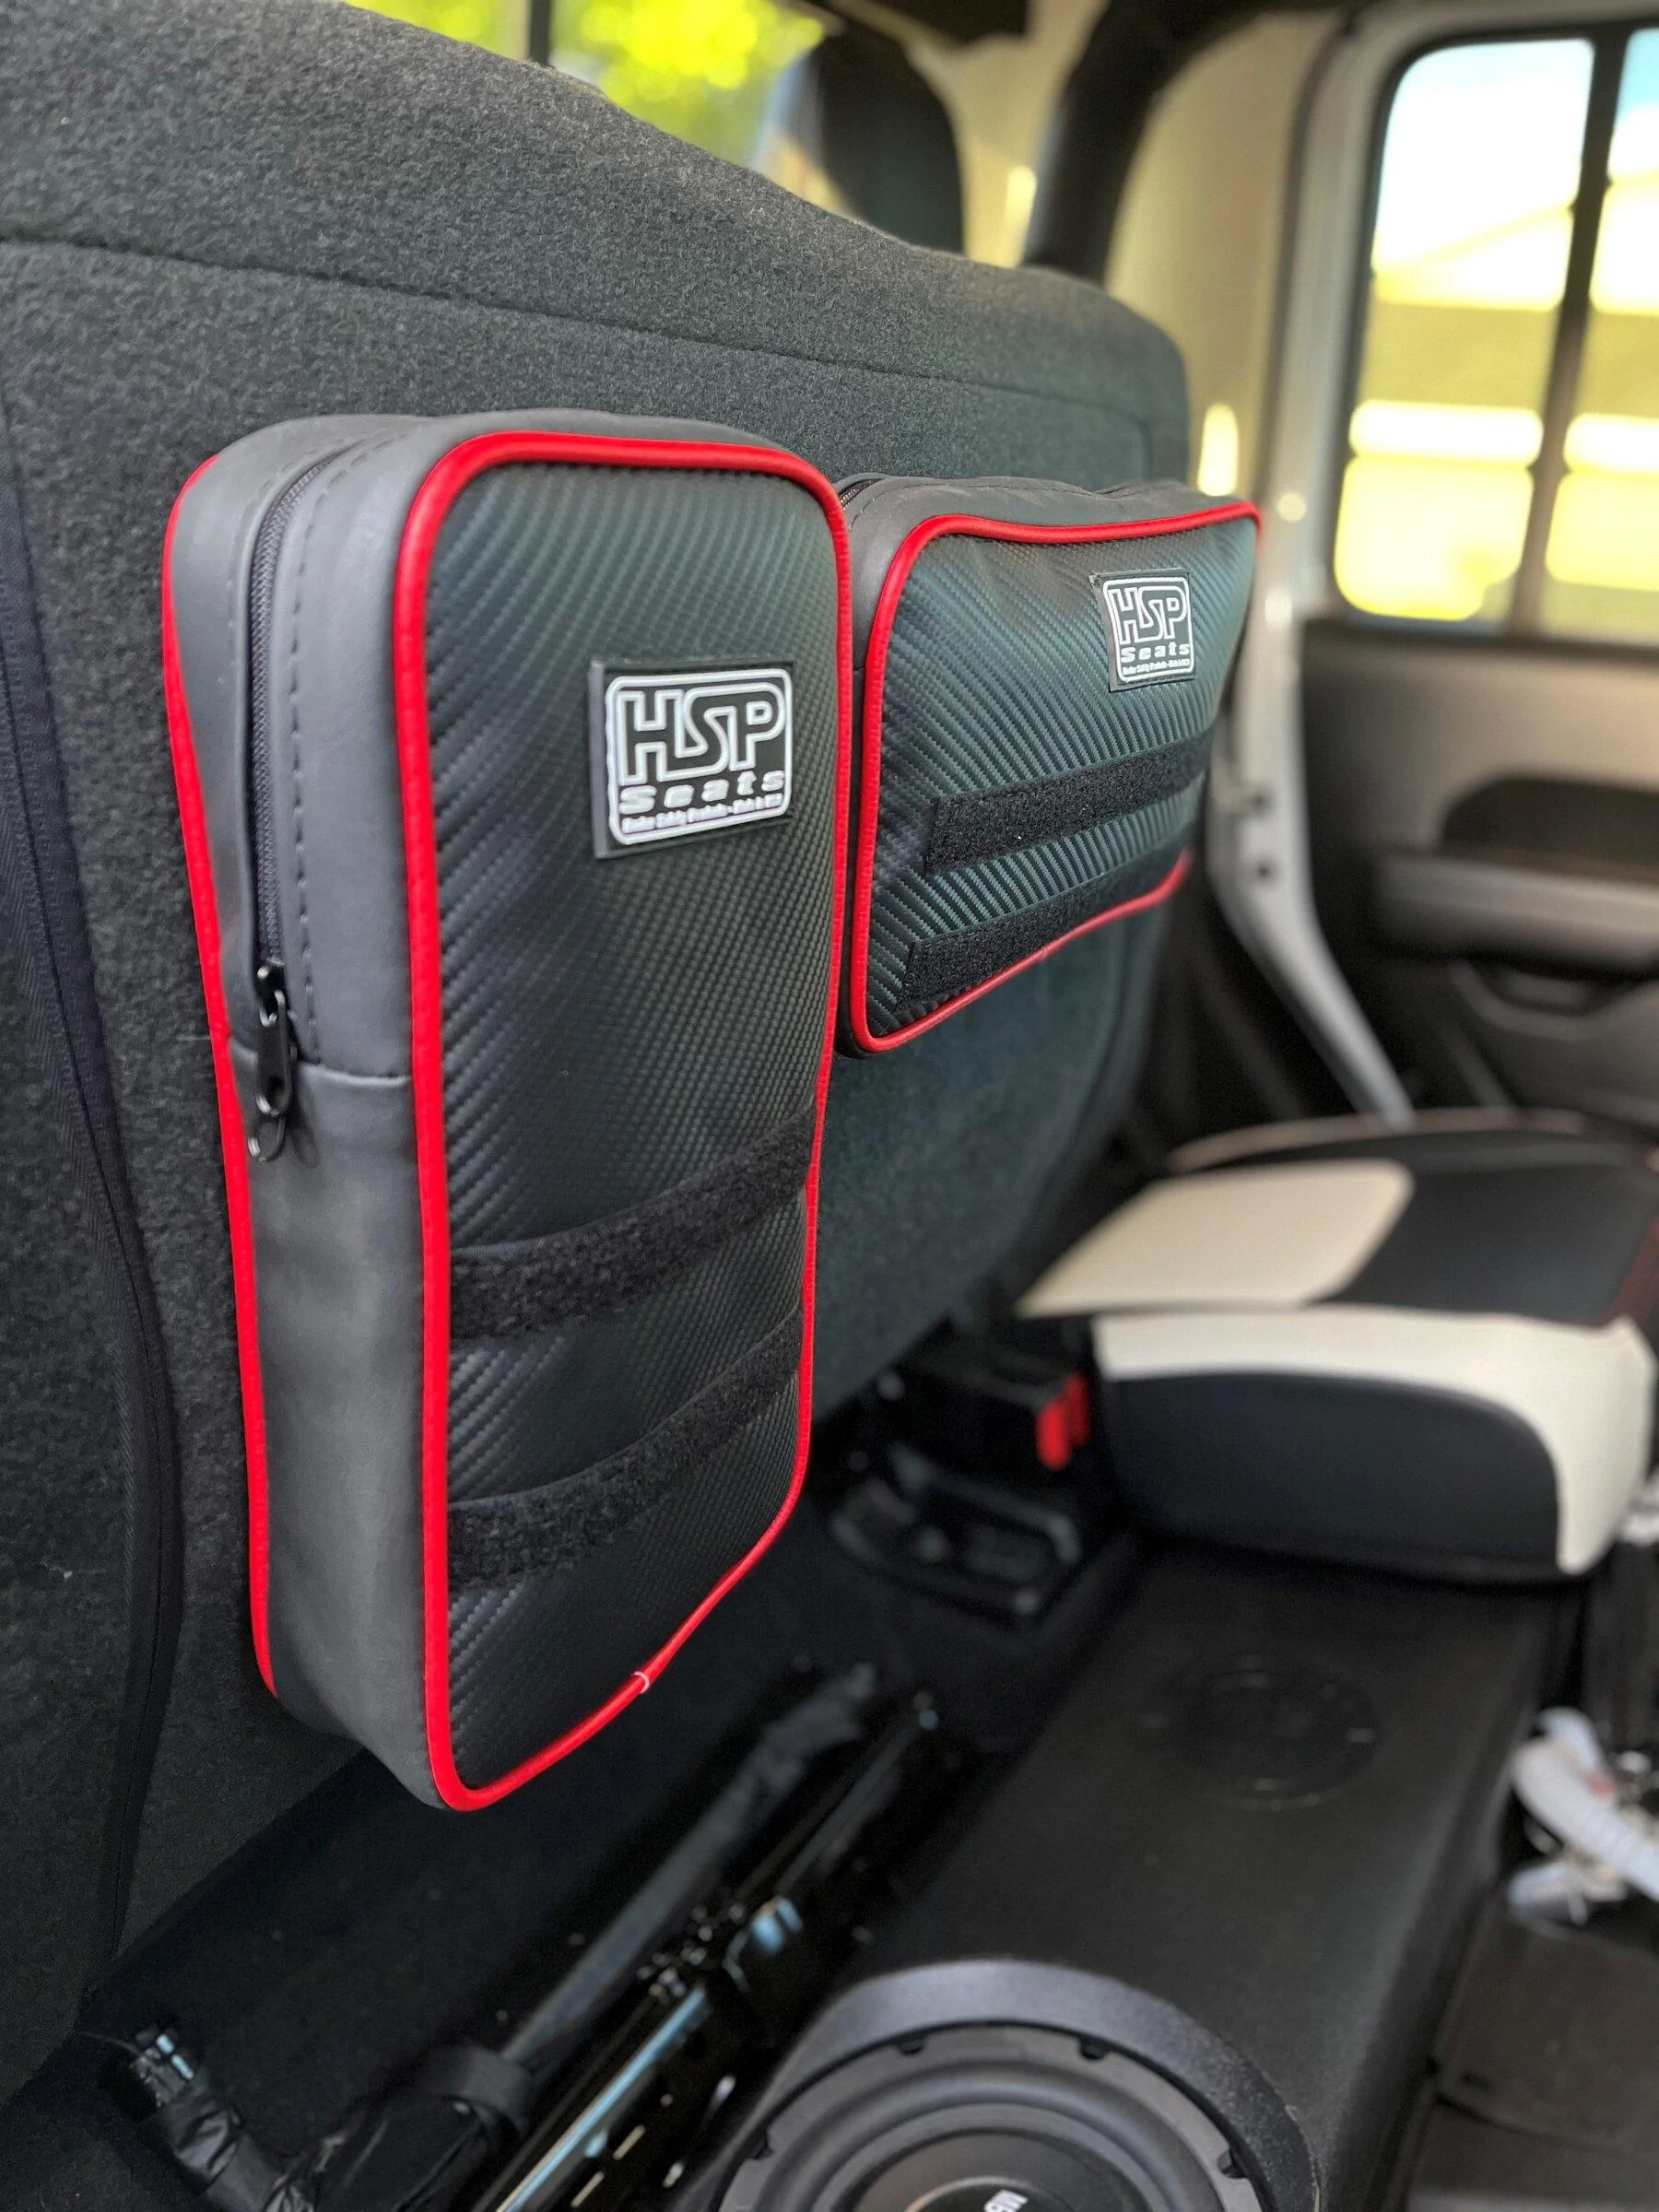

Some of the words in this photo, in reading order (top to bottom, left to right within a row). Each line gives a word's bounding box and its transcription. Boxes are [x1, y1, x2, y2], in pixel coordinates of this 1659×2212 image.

[1107, 585, 1187, 645] HSP
[1120, 641, 1190, 663] Seats
[616, 682, 786, 786] HSP
[618, 771, 784, 815] Seats
